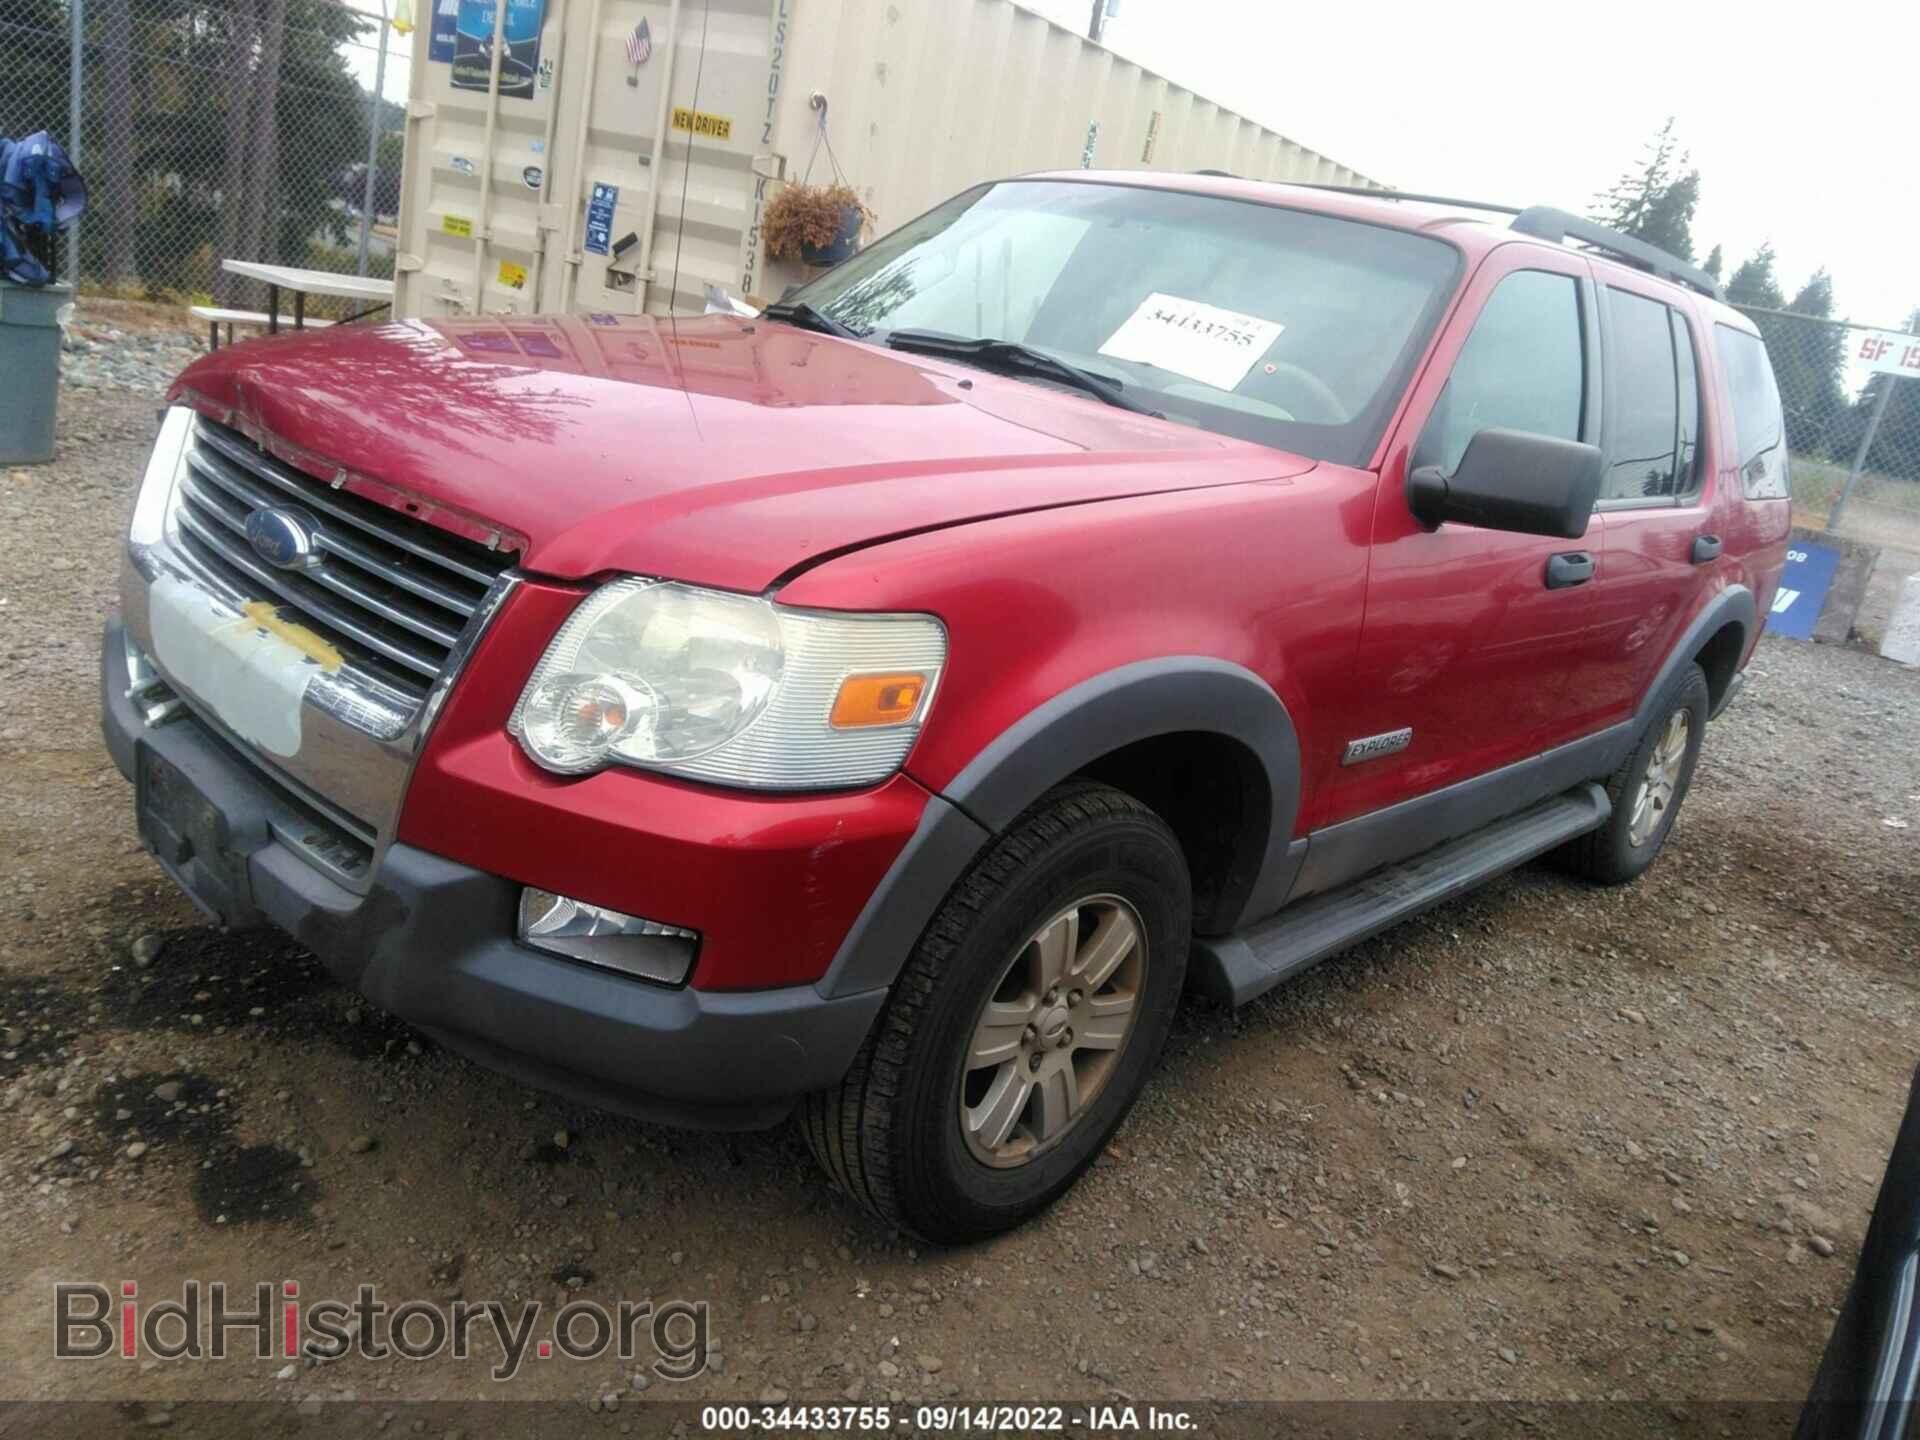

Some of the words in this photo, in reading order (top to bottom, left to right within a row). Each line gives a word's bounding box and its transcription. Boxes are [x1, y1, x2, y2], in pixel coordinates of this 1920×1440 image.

[695, 113, 731, 138] DRIVER
[1858, 337, 1894, 361] SF
[1349, 731, 1411, 757] EXPLORER
